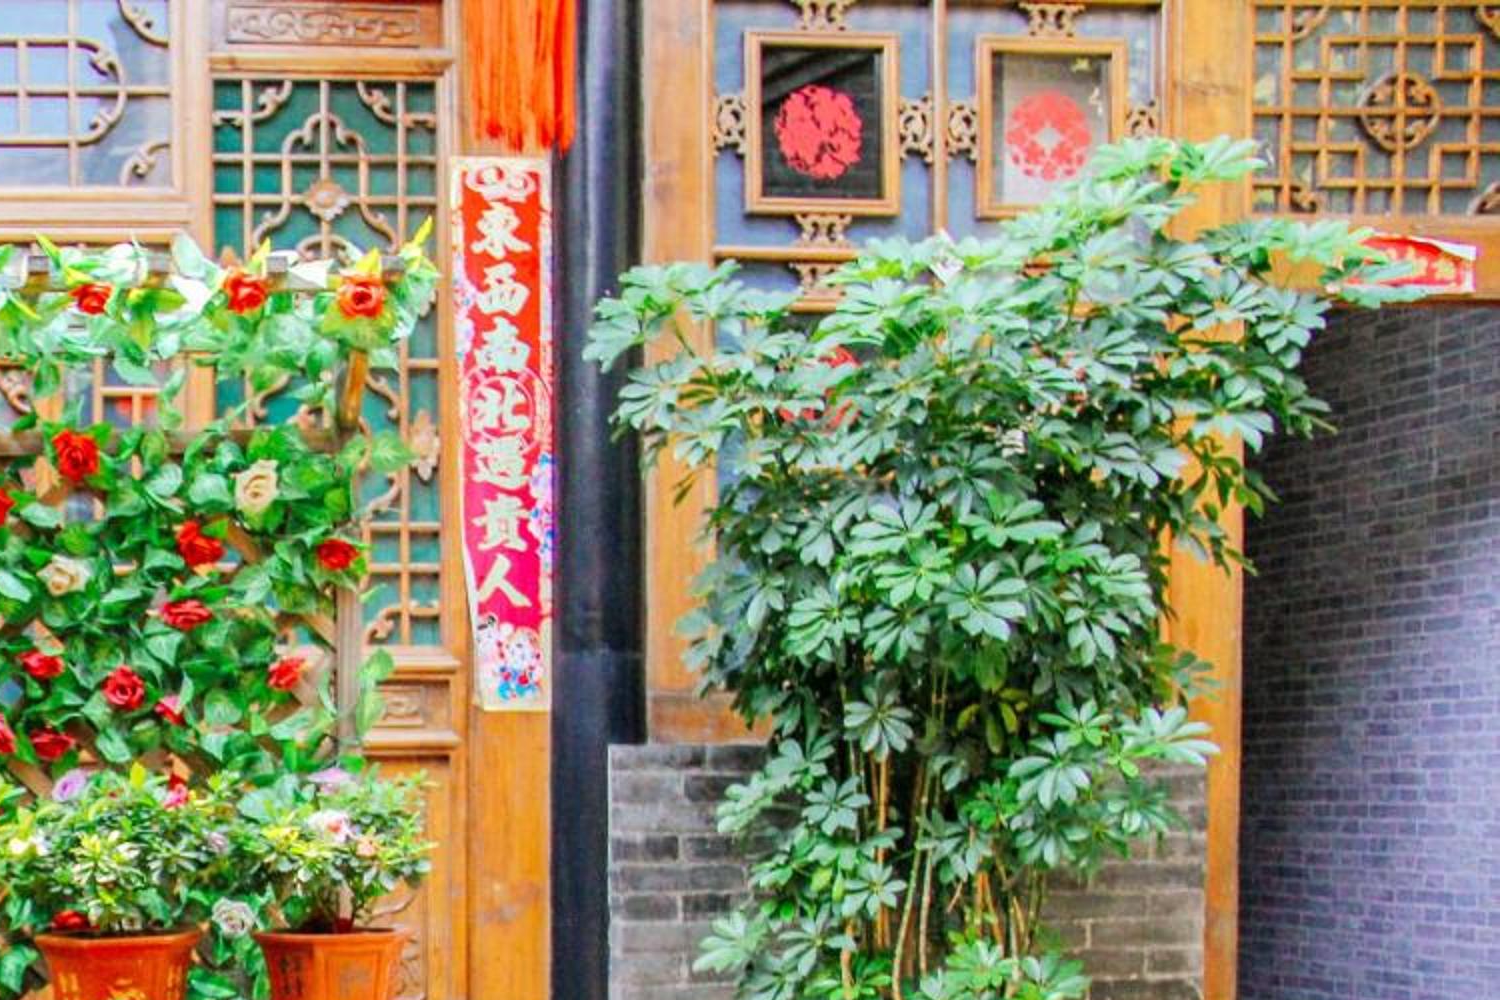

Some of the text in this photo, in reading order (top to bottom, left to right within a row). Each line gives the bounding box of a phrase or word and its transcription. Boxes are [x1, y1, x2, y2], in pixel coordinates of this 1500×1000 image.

[470, 201, 532, 607] 東西南北遇貴人
